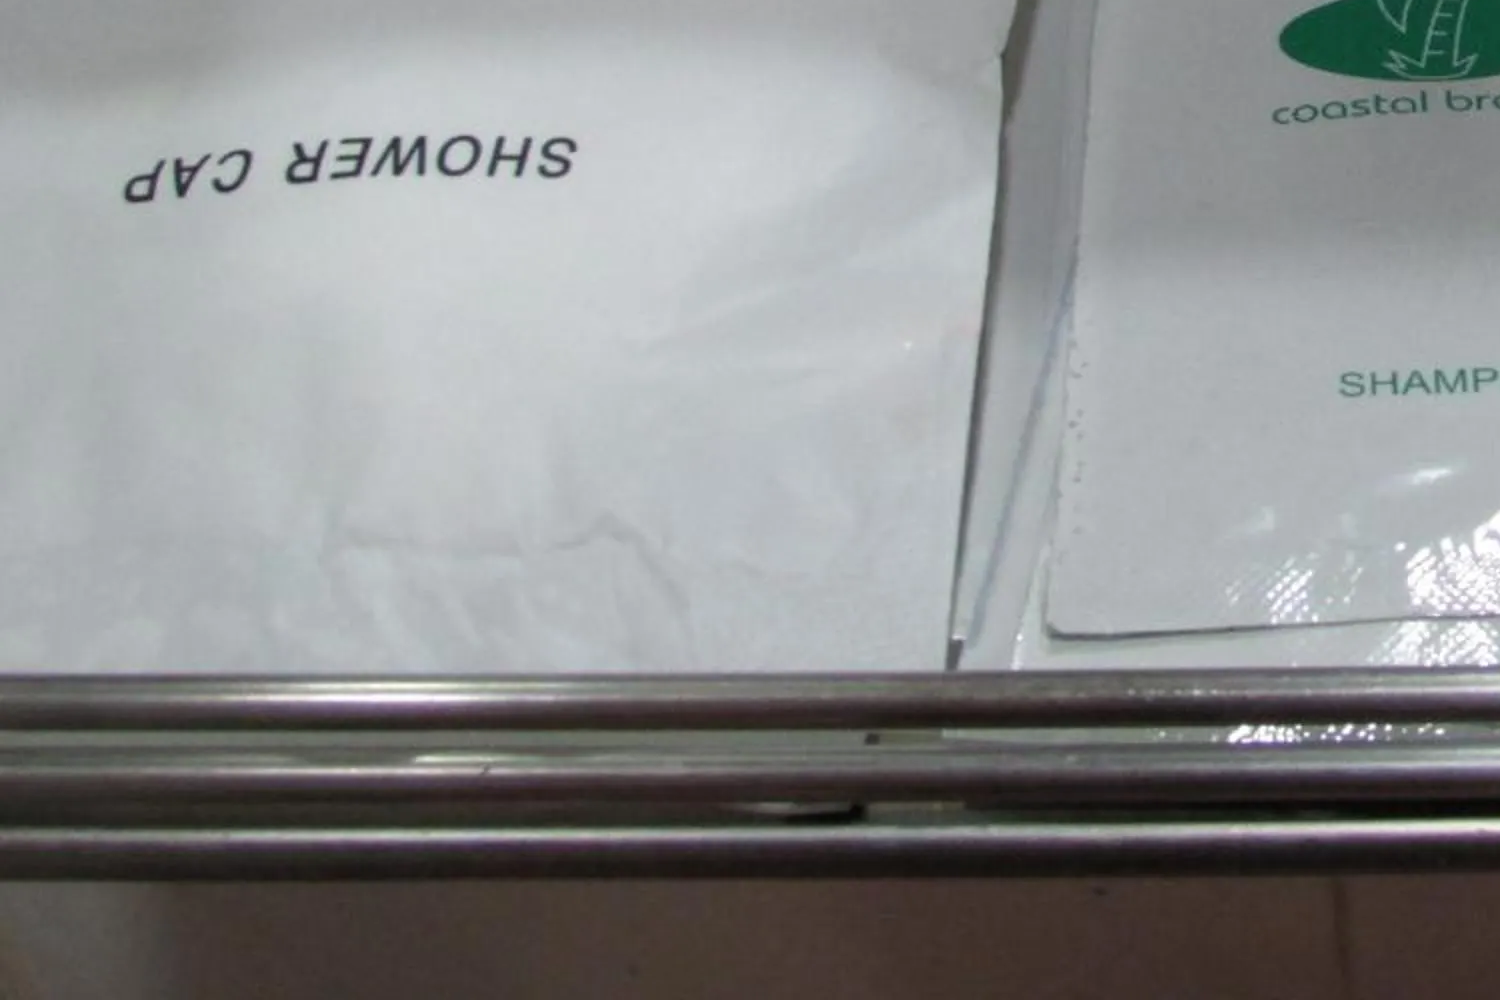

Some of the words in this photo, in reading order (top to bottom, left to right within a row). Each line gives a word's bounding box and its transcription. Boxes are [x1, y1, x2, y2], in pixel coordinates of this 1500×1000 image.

[1271, 90, 1428, 125] coastal
[123, 149, 252, 204] CAP
[285, 135, 577, 182] SHOWER
